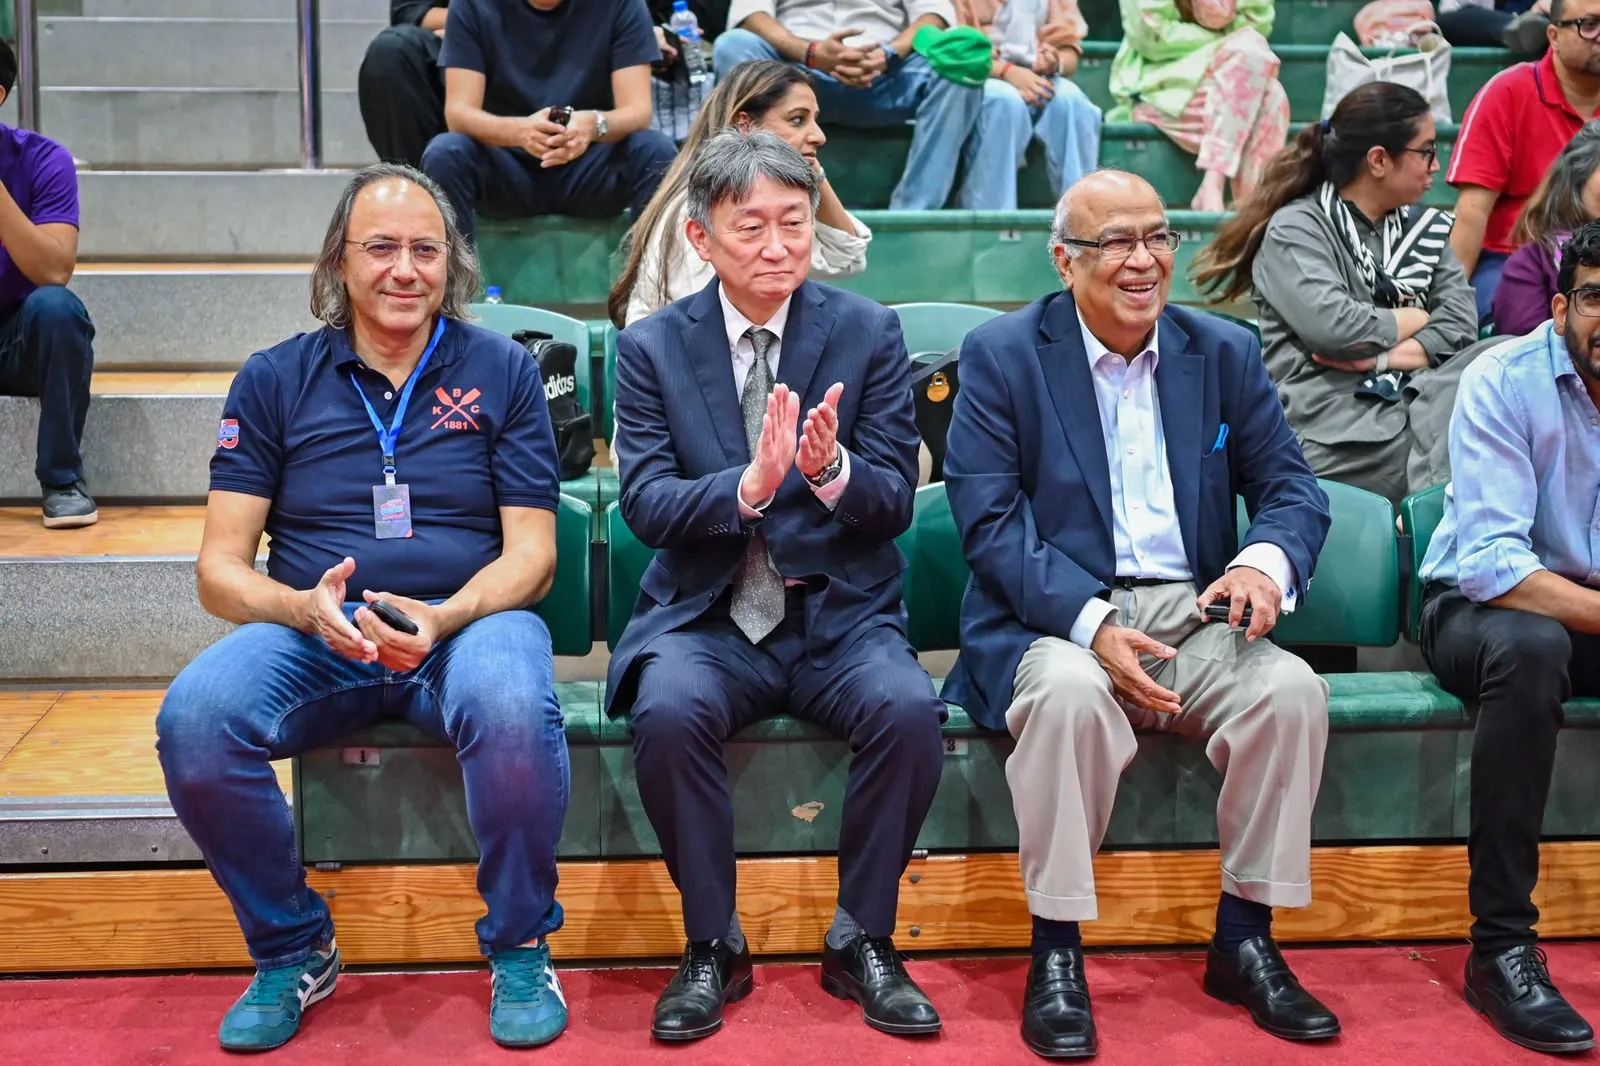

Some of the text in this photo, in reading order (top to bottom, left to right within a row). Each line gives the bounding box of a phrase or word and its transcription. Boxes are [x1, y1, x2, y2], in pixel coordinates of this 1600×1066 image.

[452, 388, 462, 398] B
[432, 405, 442, 415] K
[443, 420, 468, 430] 1881
[947, 738, 956, 752] 3
[359, 749, 366, 763] 1
